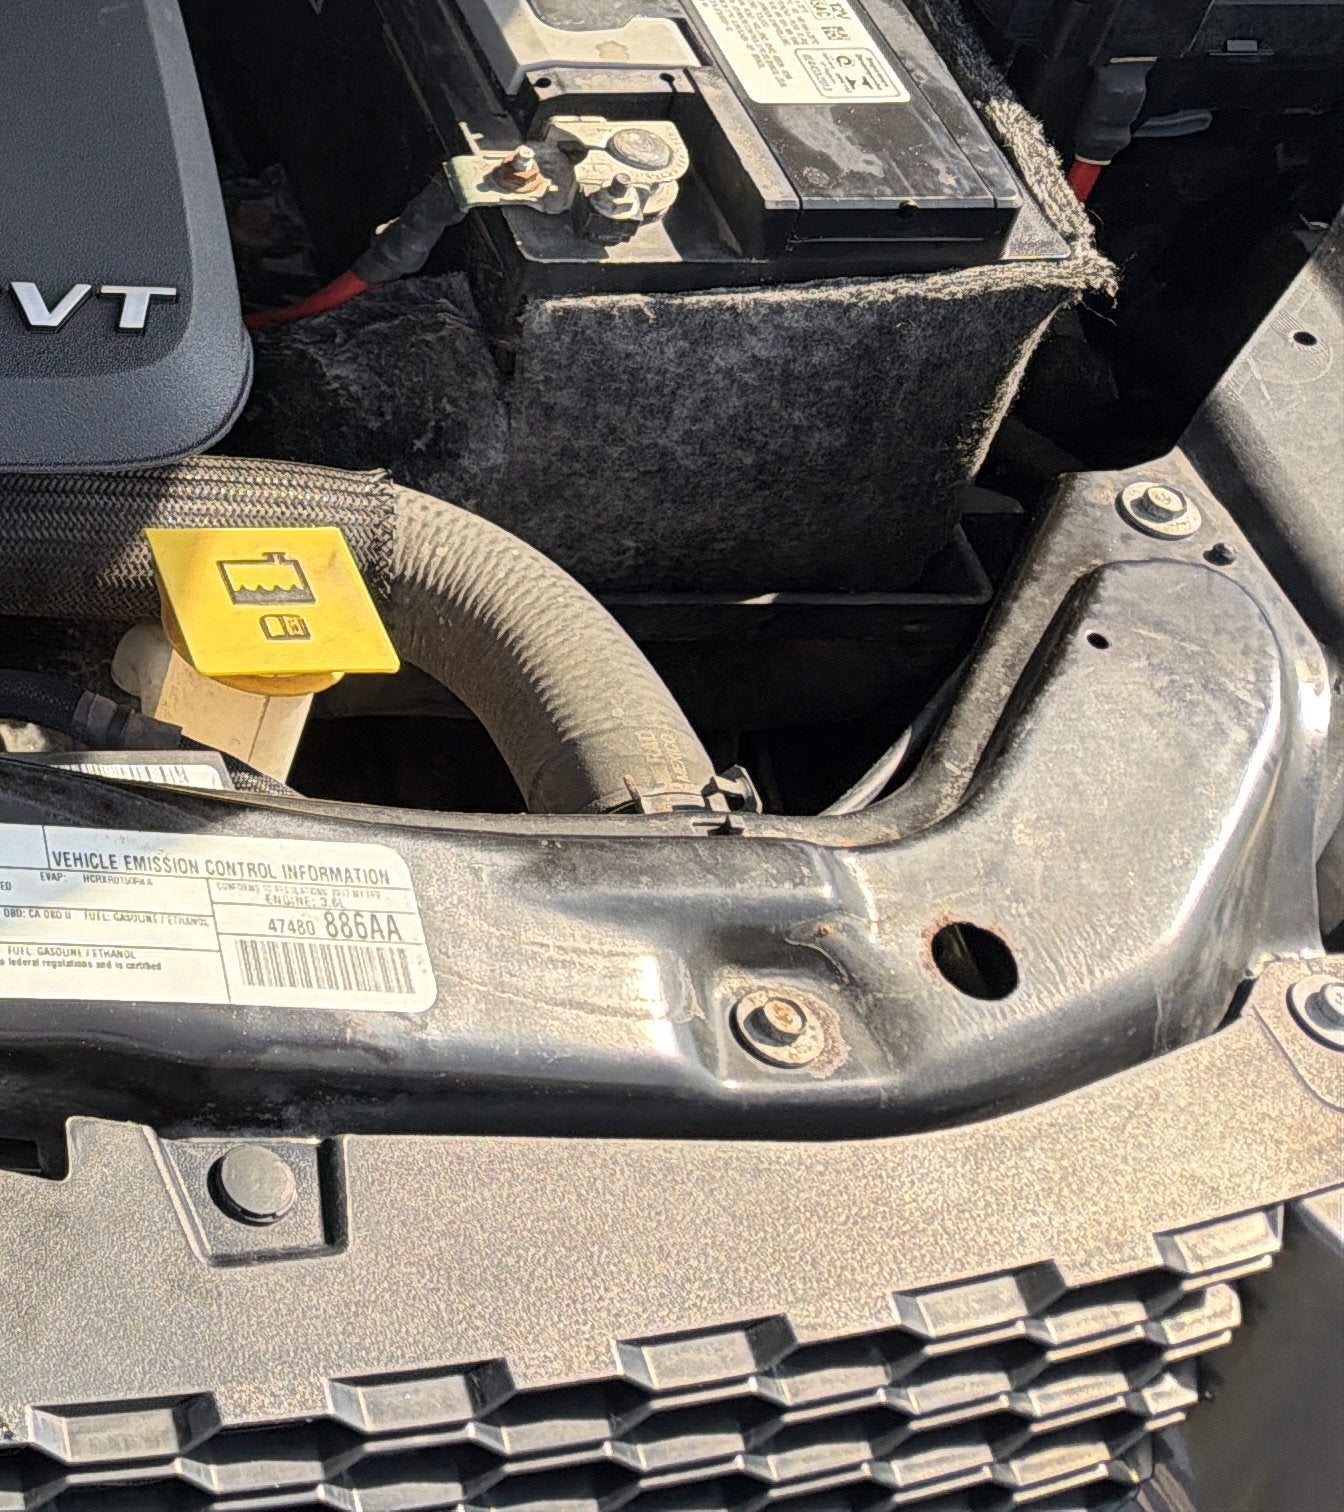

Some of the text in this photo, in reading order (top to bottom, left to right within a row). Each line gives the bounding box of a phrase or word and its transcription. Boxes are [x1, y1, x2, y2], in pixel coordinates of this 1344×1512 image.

[51, 850, 390, 886] VEHICLE EMISSION CONTROL INFORMATION
[39, 871, 67, 882] EVAP:
[264, 894, 316, 907] ENGINE:
[2, 908, 26, 918] OBD:
[266, 909, 403, 941] 47480 886AA
[6, 945, 34, 956] FUEL:
[36, 946, 82, 958] GASOLINE
[91, 948, 136, 959] ETHANOL
[7, 957, 39, 967] federal
[41, 958, 92, 970] regulations
[95, 959, 112, 969] and
